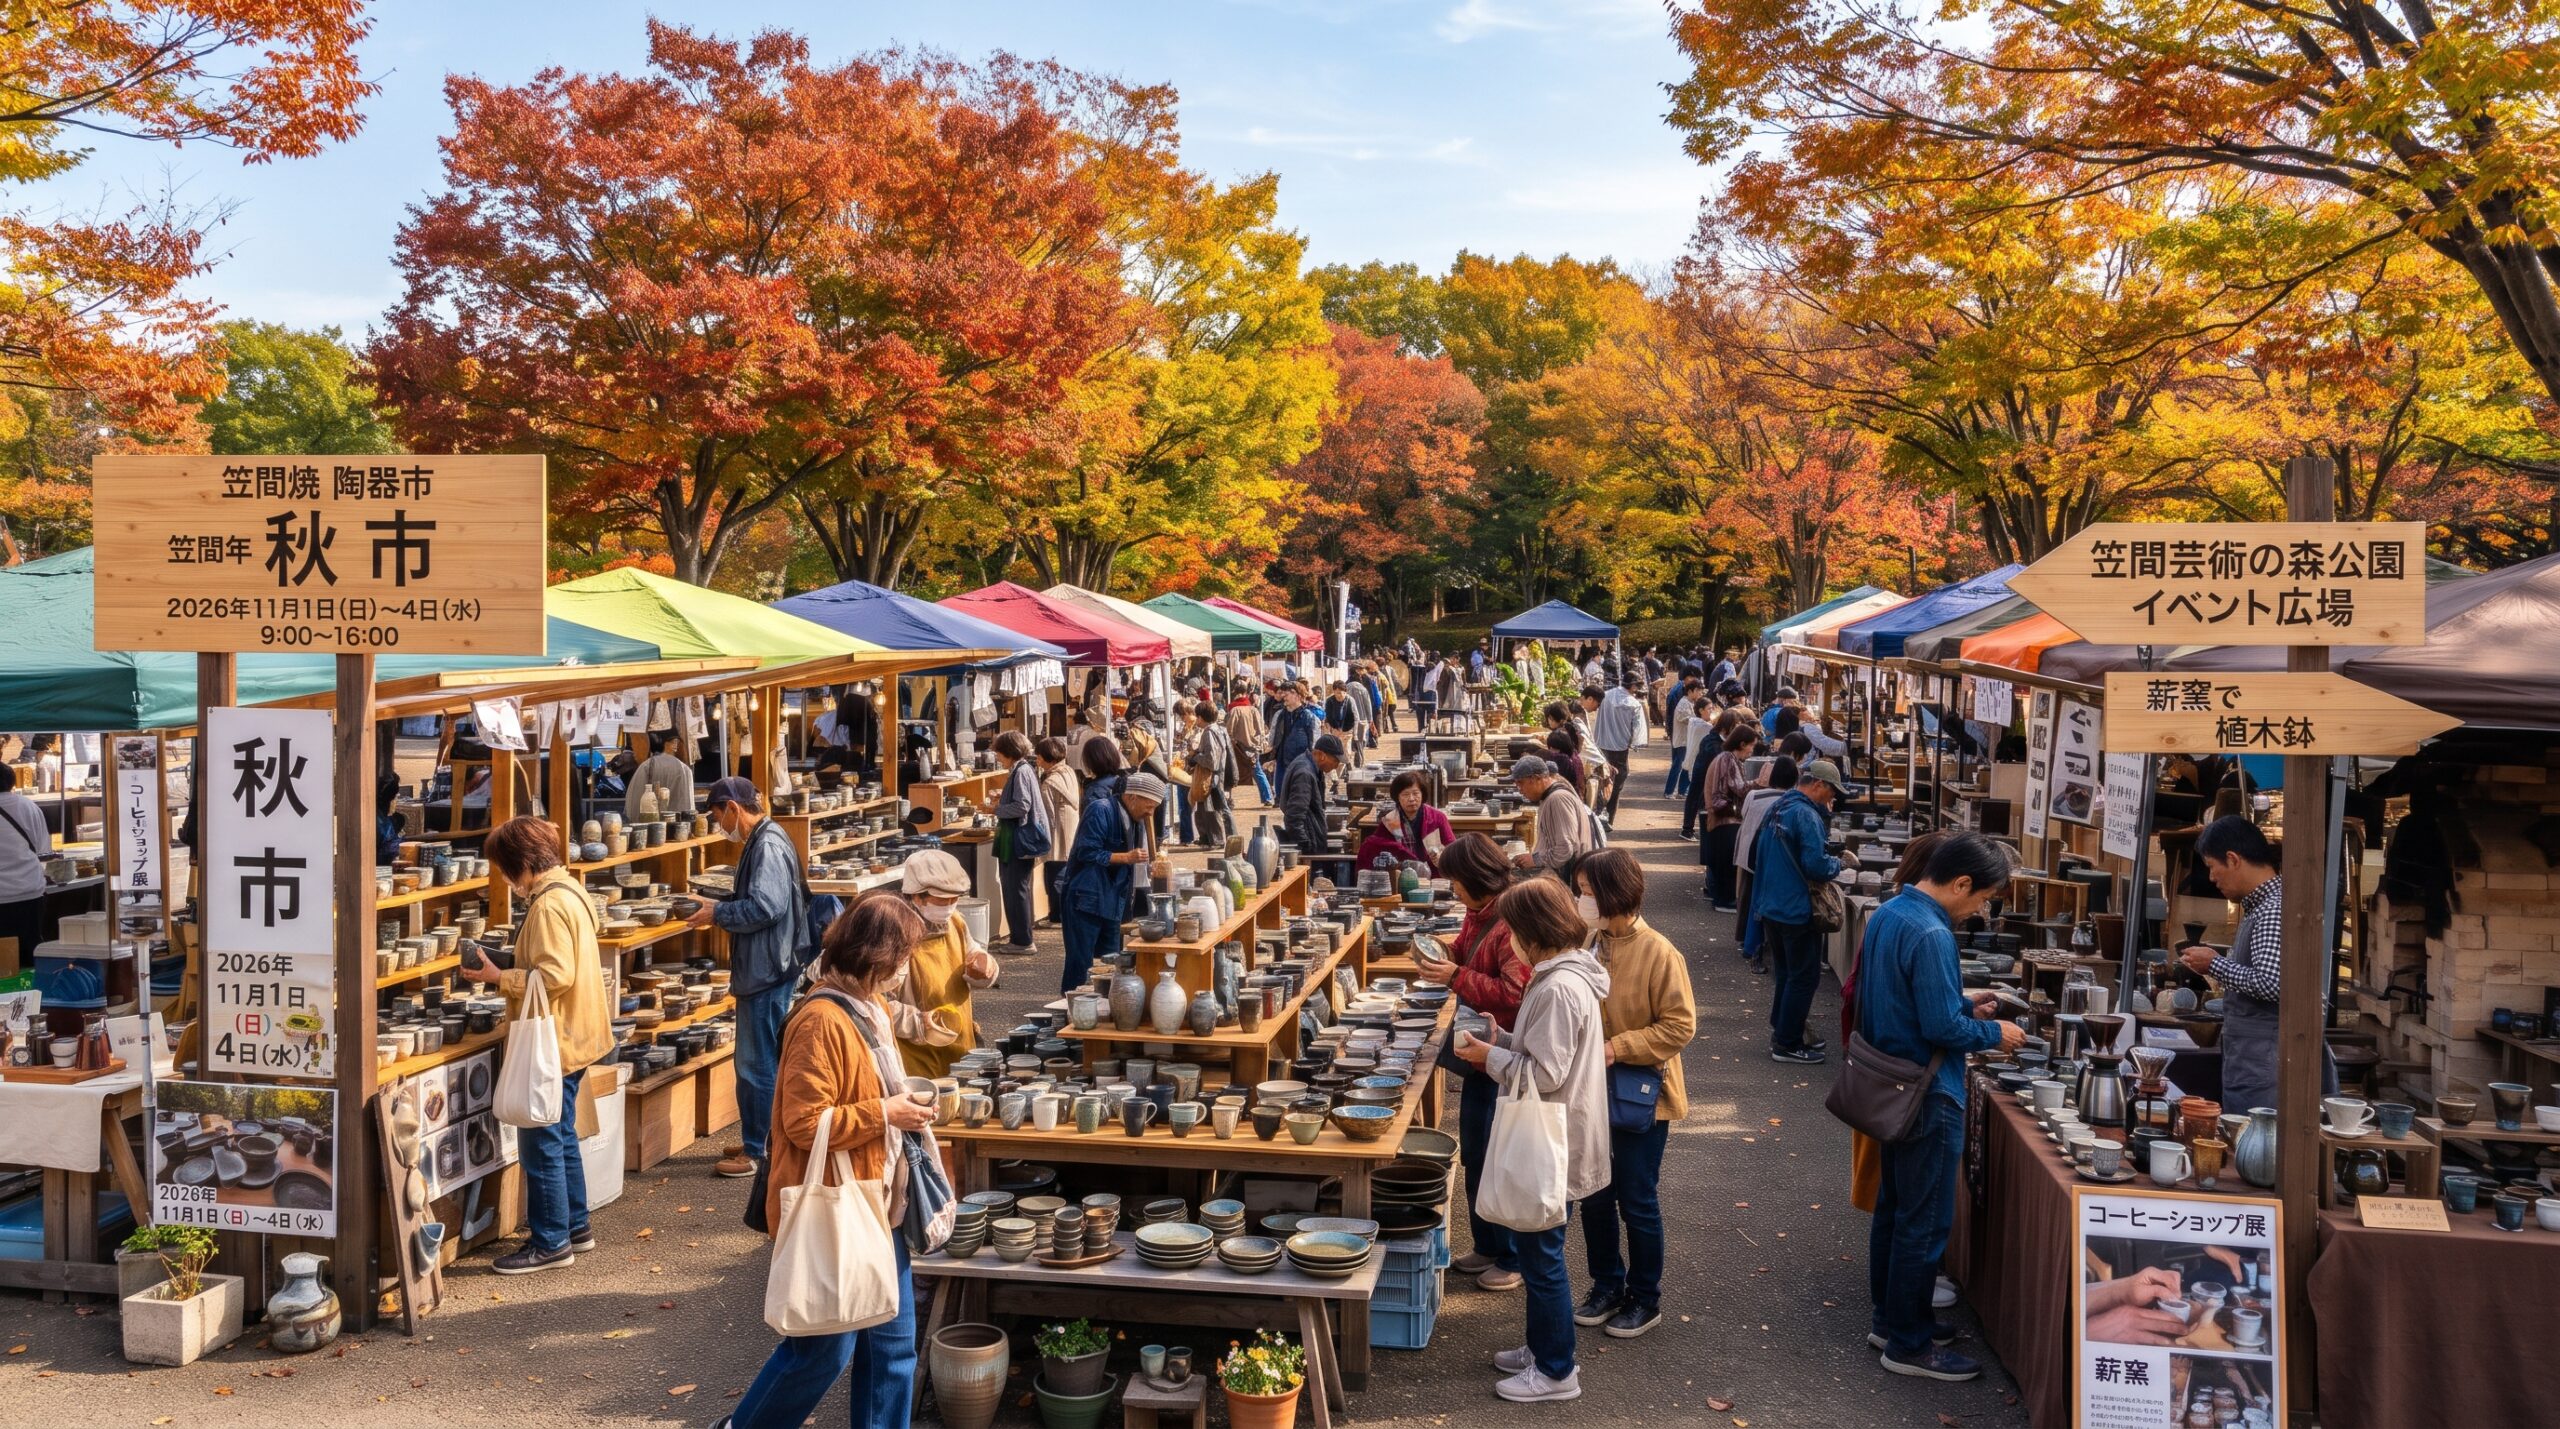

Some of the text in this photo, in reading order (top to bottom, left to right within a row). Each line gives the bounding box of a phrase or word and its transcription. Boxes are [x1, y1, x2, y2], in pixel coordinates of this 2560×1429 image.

[221, 464, 434, 500] 笠間焼 陶器市
[167, 534, 253, 565] 笠間年
[2090, 539, 2405, 581] 笠間芸術の森公園
[2132, 587, 2355, 628] イベント広場
[260, 625, 400, 647] 9:00～16:00
[2146, 678, 2242, 712] 薪窯で
[2215, 715, 2316, 749] 植木鉢
[232, 736, 309, 928] 秋市
[216, 952, 294, 977] 2026年
[217, 982, 305, 1009] 11月1日
[215, 1032, 301, 1068] 4日（水）
[159, 1185, 217, 1204] 2026年
[2088, 1205, 2267, 1238] コーヒーショップ展
[2095, 1356, 2150, 1386] 薪窯
